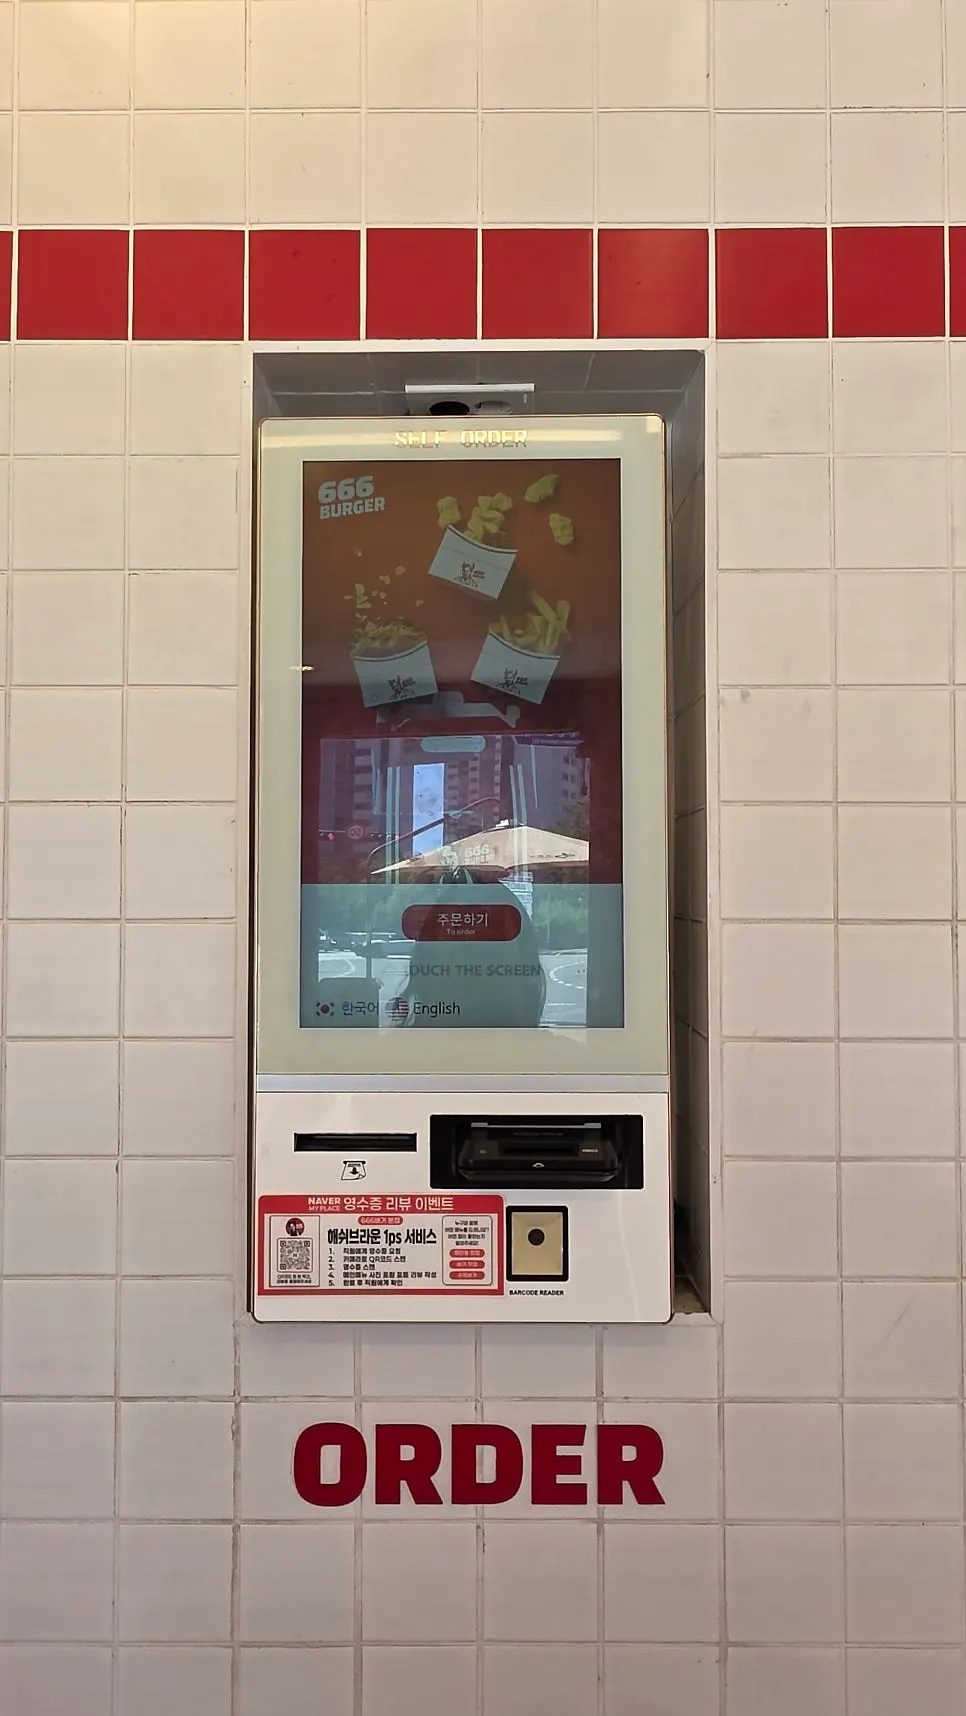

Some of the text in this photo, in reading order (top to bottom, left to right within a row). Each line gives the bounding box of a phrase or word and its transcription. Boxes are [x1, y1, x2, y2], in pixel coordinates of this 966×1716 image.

[393, 429, 528, 448] SELF ORDER
[318, 475, 374, 504] 666
[320, 496, 385, 520] BURGER
[437, 912, 488, 927] 주문하기
[407, 964, 541, 977] OUCH THE SCREEN
[342, 1001, 379, 1016] 한국어
[413, 1001, 461, 1018] English
[308, 1197, 341, 1205] NAVER
[343, 1197, 455, 1211] 영수증 리뷰 이벤트
[328, 1228, 437, 1246] 해쉬브라운 1ps 서비스
[343, 1247, 368, 1255] 직원에게
[293, 1422, 666, 1507] ORDER
